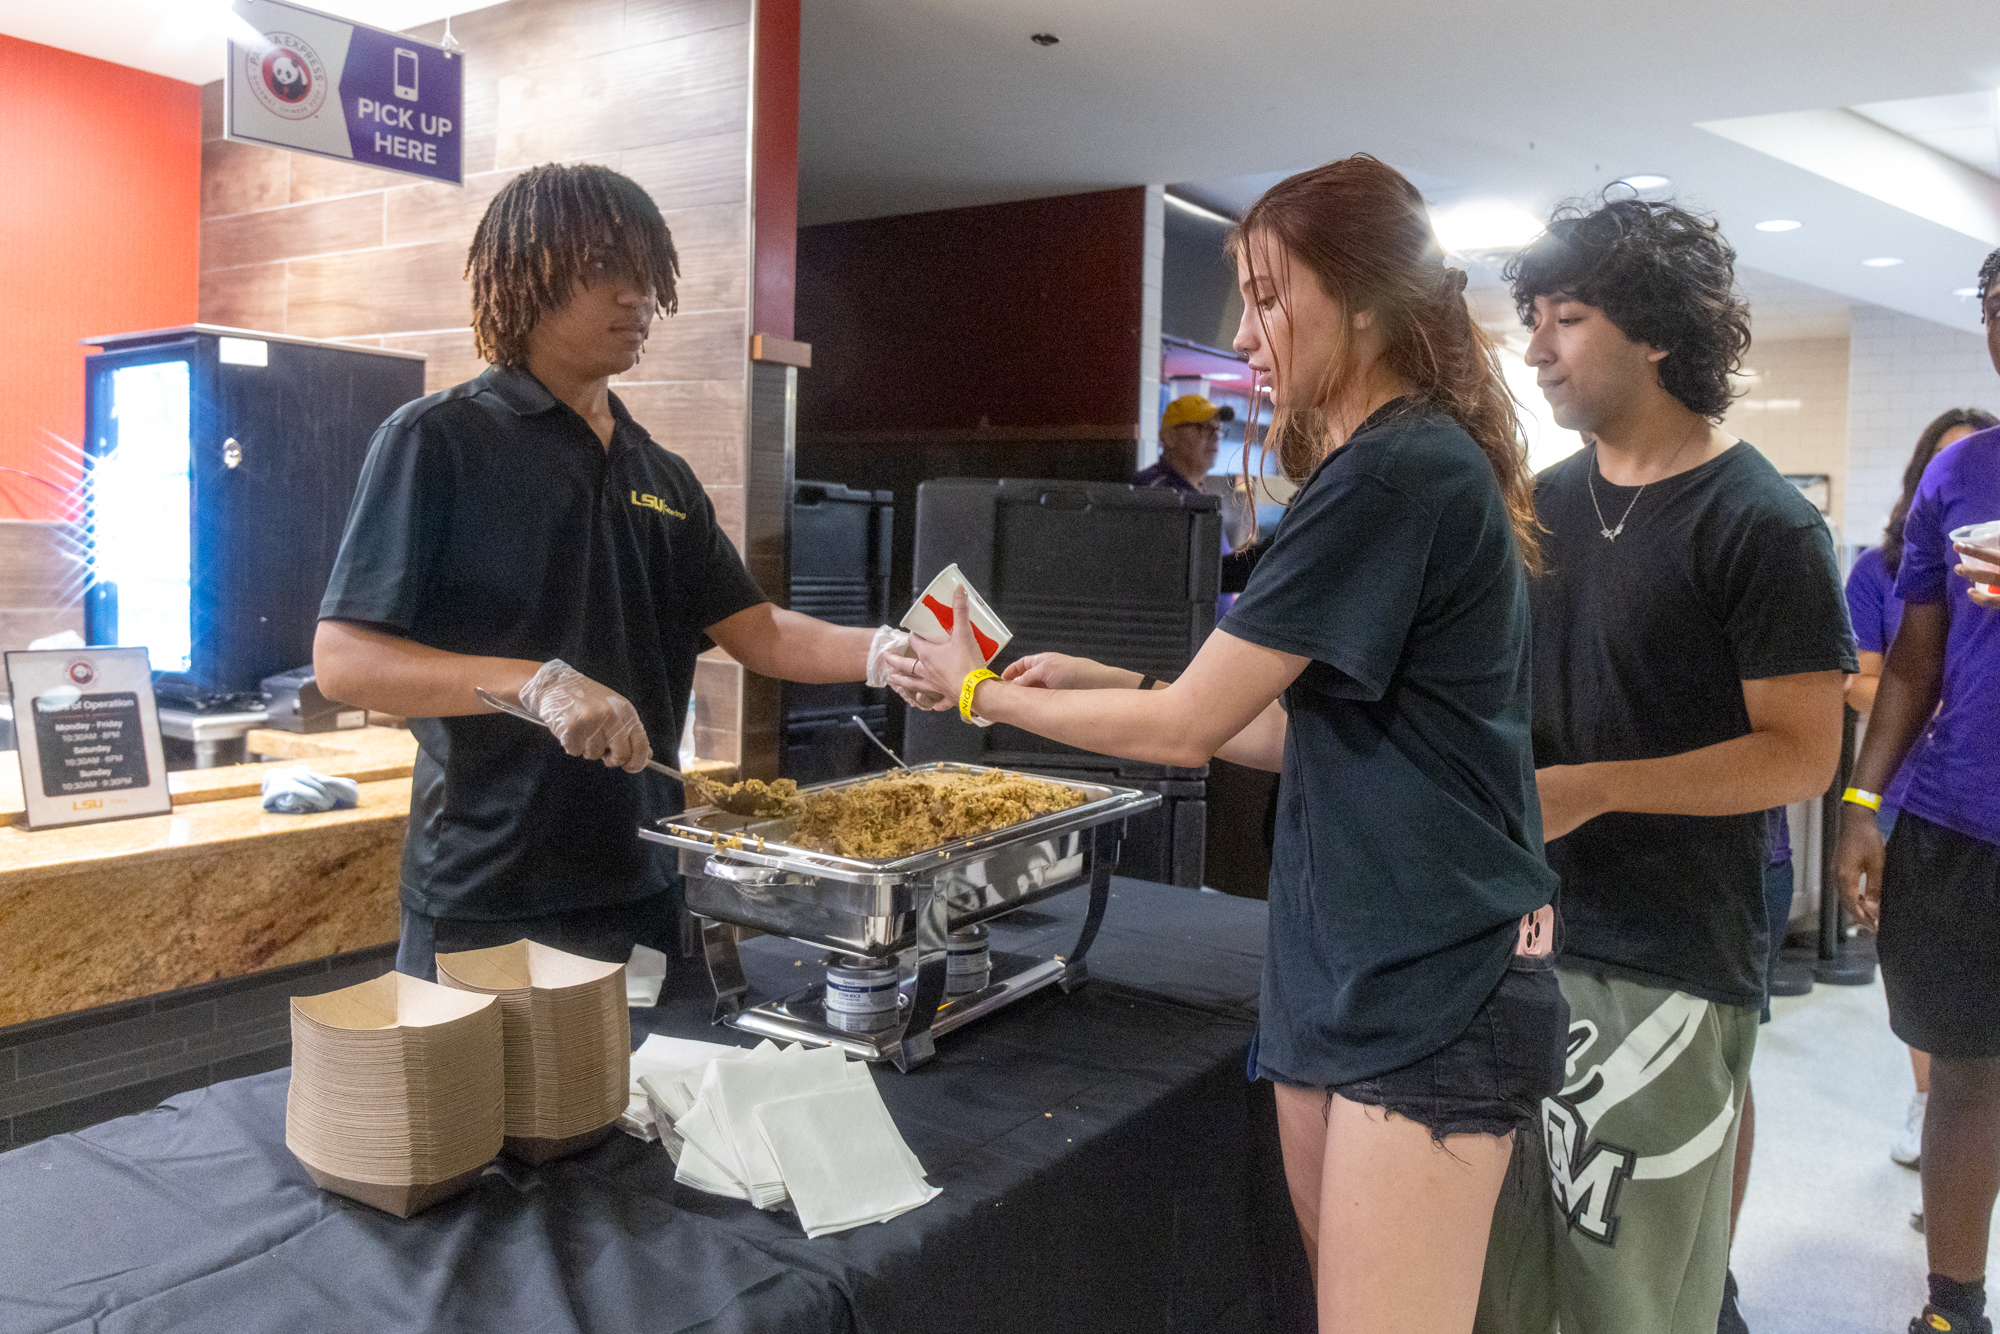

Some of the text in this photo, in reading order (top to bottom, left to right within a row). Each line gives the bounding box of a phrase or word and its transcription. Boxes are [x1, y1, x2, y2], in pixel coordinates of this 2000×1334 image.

[285, 35, 323, 81] EXPRESS
[358, 97, 453, 138] PICK UP
[374, 131, 437, 165] HERE
[631, 490, 664, 513] LSU
[963, 678, 974, 711] NIGHT
[83, 698, 135, 711] Operation
[54, 722, 91, 732] Monday
[96, 720, 123, 729] Friday
[73, 744, 112, 755] Saturday
[79, 768, 112, 778] Sunday
[72, 798, 104, 811] LSU
